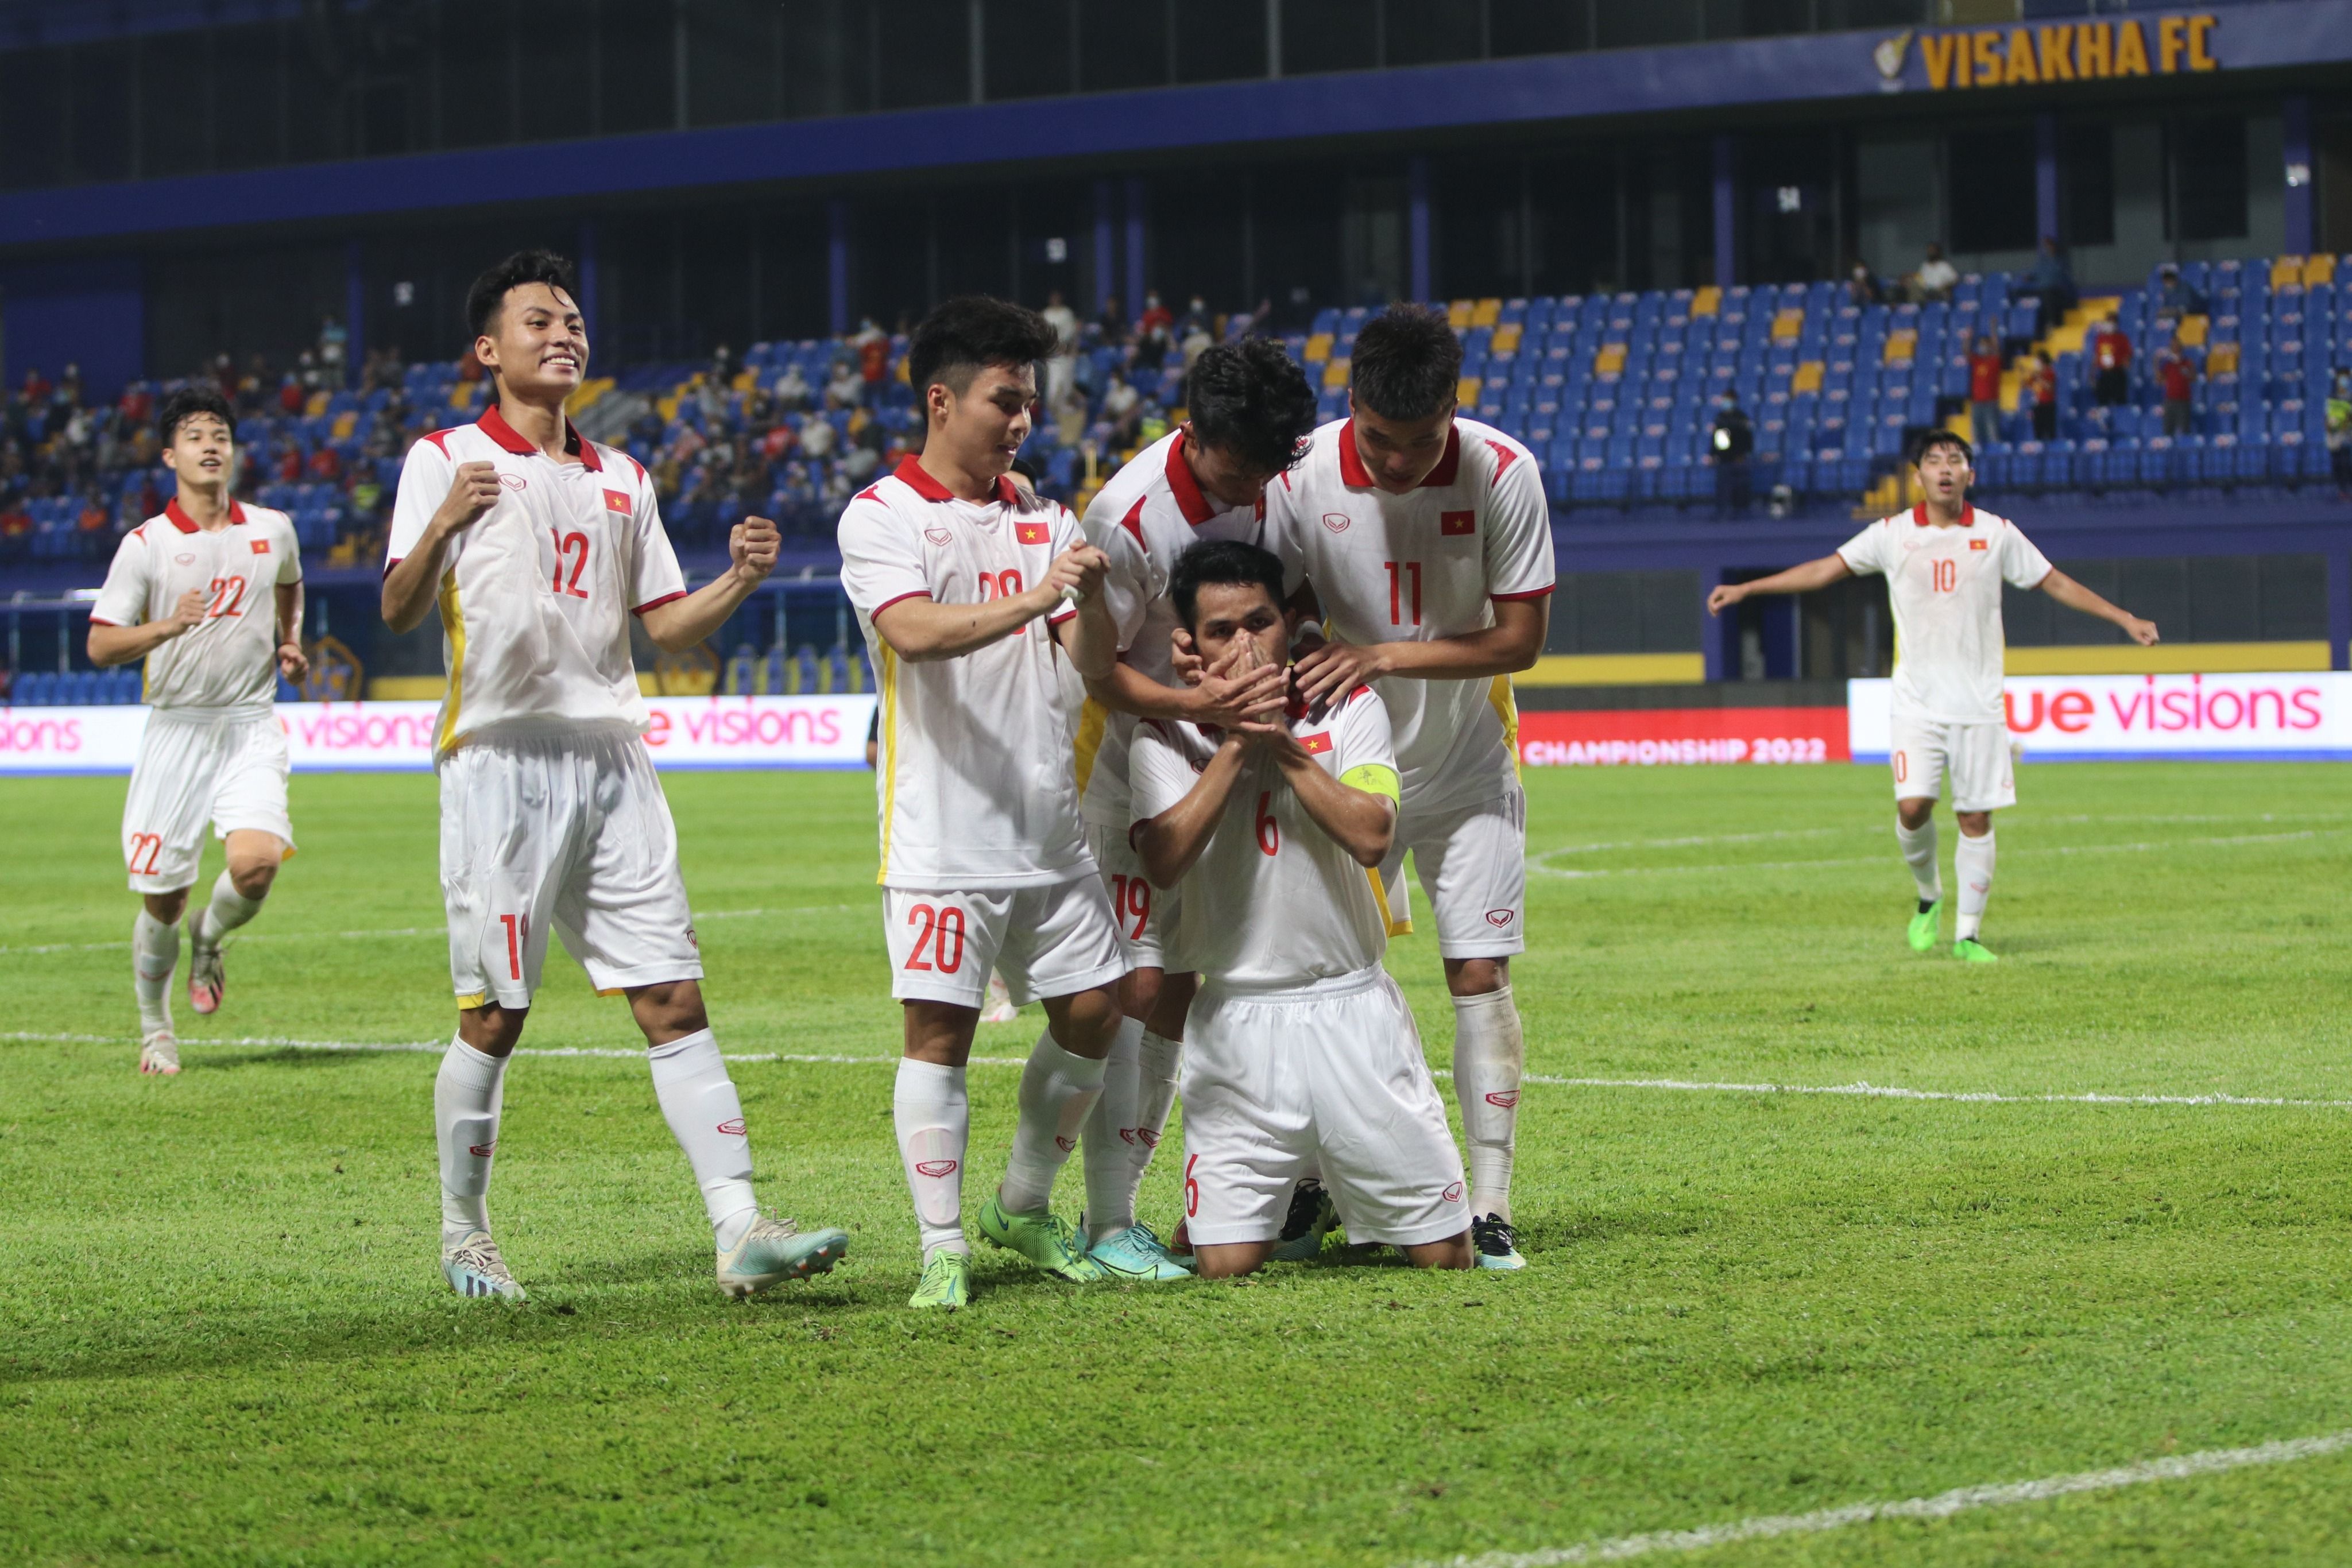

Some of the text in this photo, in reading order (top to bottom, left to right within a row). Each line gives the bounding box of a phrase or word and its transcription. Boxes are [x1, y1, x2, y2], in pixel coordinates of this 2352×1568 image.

[1920, 15, 2216, 90] VISAKHA FC
[551, 528, 589, 599] 12
[1384, 561, 1421, 626] 11
[1932, 559, 1956, 592] 10
[209, 575, 246, 617] 22
[0, 706, 82, 753] ions
[684, 695, 840, 745] visions
[2003, 674, 2322, 733] ue visions
[1523, 737, 1827, 766] CHAMPIONSHIP 2022
[1893, 750, 1907, 783] 0
[129, 833, 161, 875] 22
[1256, 792, 1279, 856] 6
[1112, 873, 1151, 940] 19
[500, 913, 528, 980] 1
[904, 903, 965, 974] 20
[1185, 1153, 1199, 1217] 6
